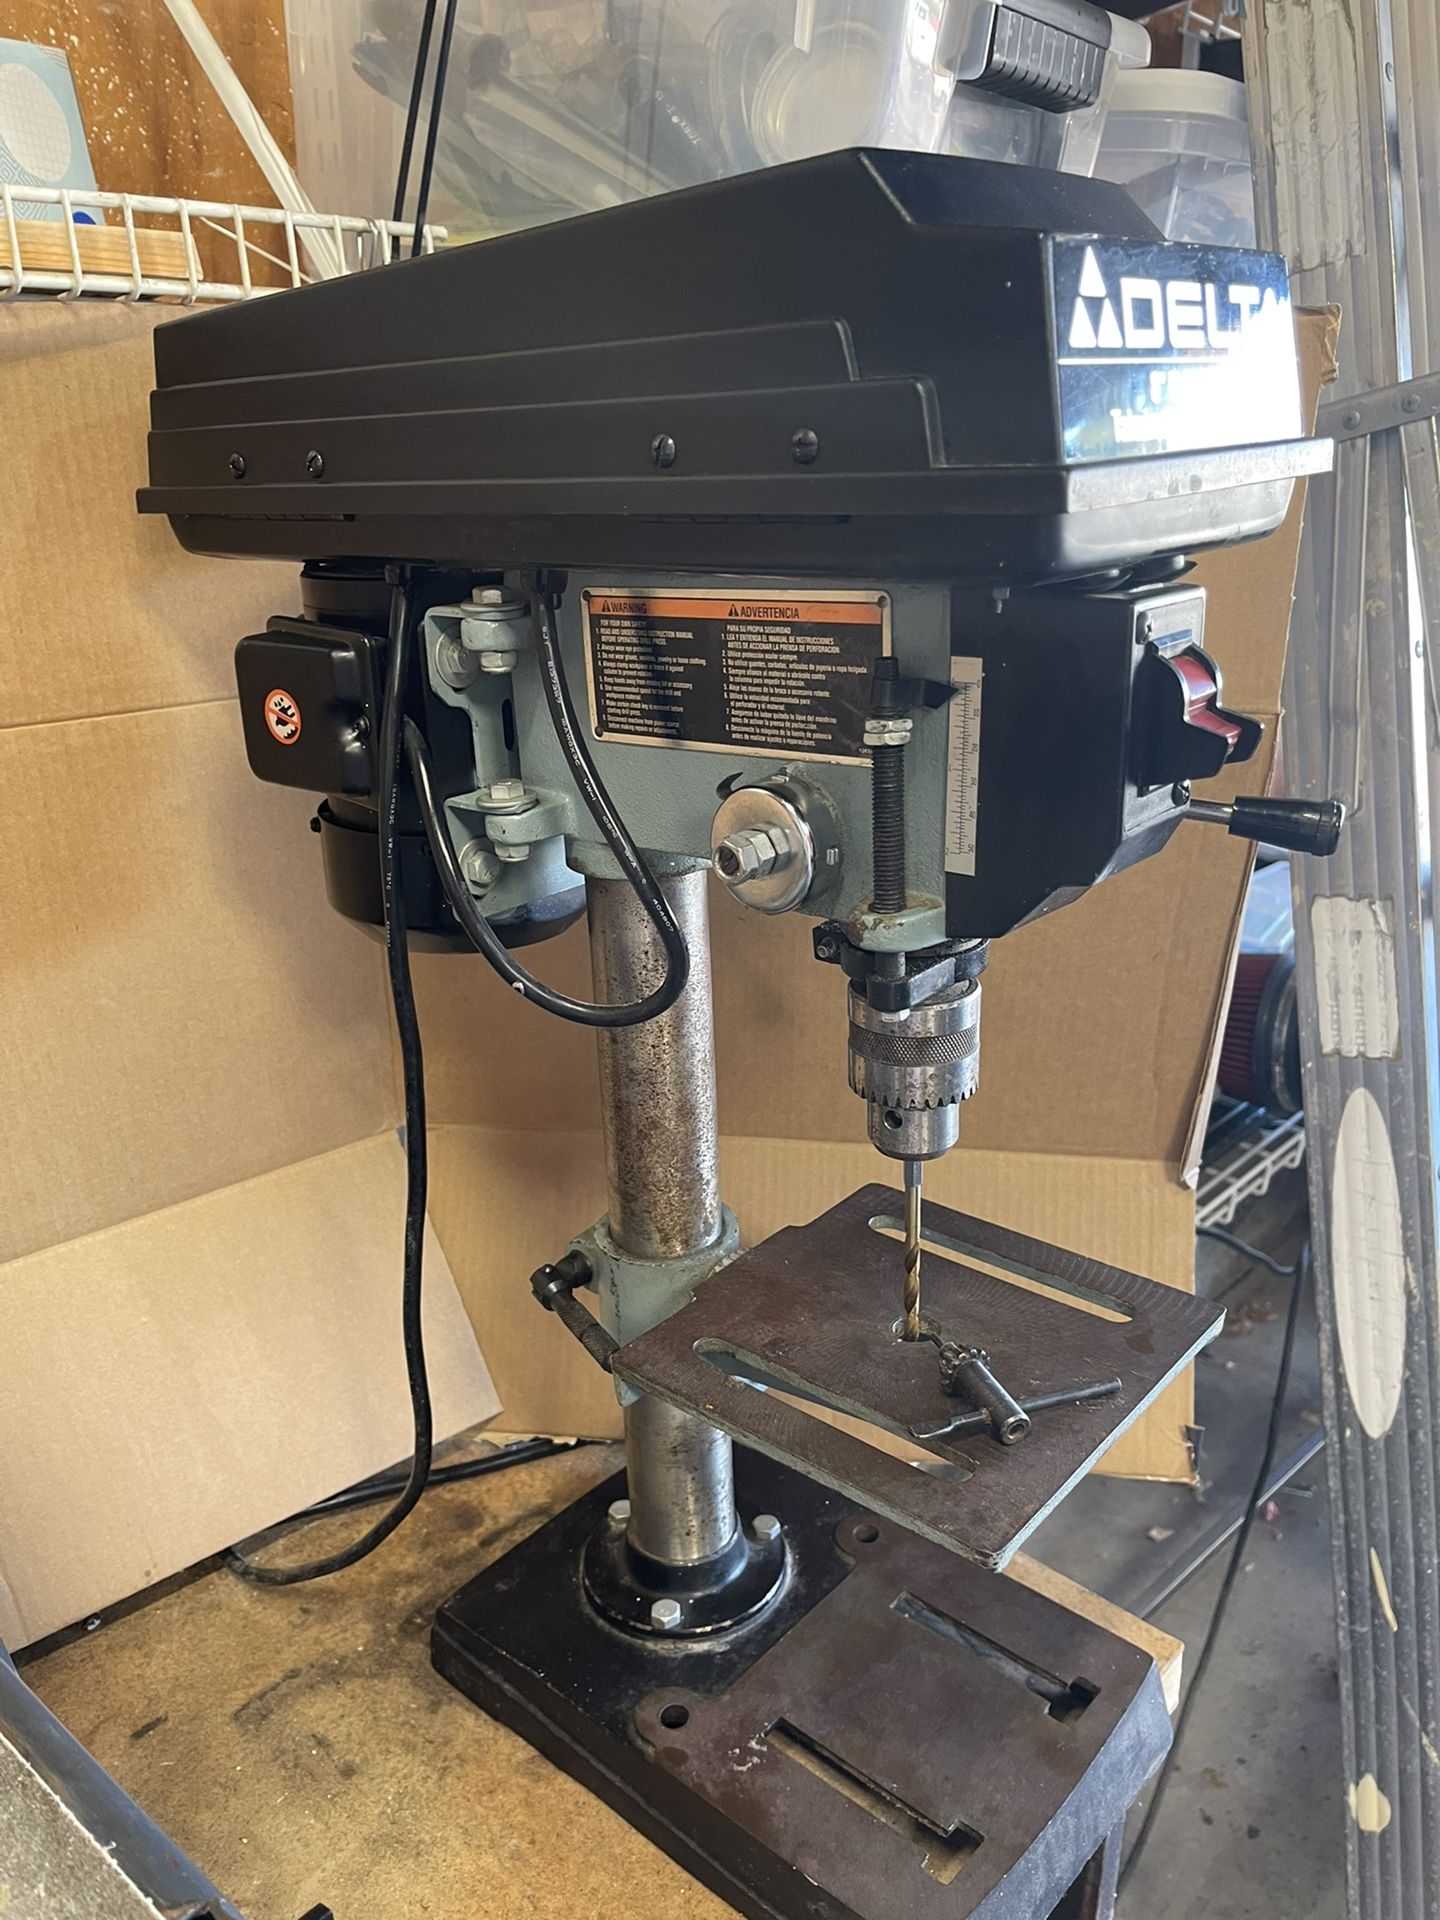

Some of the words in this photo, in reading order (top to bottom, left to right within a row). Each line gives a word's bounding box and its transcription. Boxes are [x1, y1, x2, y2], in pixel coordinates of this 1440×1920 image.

[1120, 277, 1290, 349] DELT
[610, 602, 647, 613] WARNING
[739, 606, 799, 618] ADVERTENCIA
[764, 625, 791, 634] SEGURIDAD
[795, 636, 833, 644] INSTRUCCIONES
[749, 642, 771, 650] ACCIONAR
[779, 643, 797, 651] PRENSA
